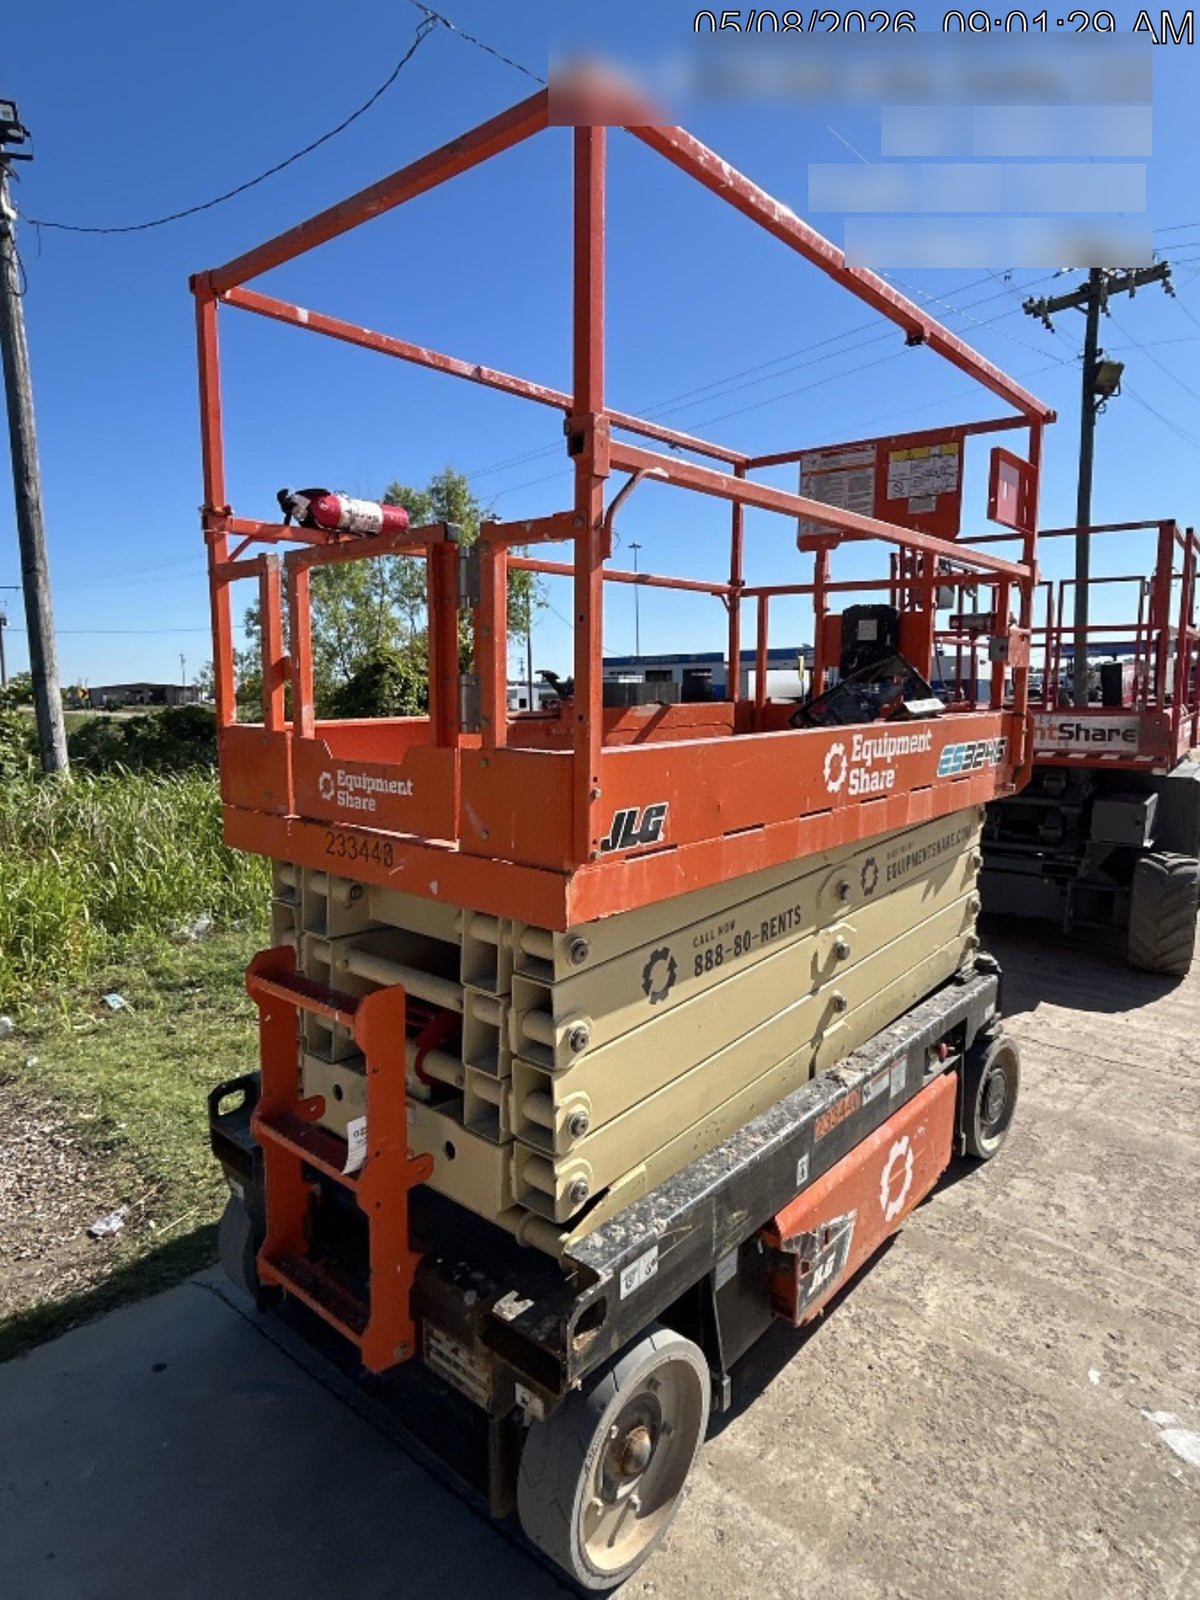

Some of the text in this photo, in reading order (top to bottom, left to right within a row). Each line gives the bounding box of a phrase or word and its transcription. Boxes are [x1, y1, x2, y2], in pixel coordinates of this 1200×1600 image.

[851, 728, 933, 766] Equipment
[337, 769, 413, 795] Equipment
[848, 767, 896, 795] Share
[337, 790, 376, 811] Share
[600, 801, 669, 850] JLG
[694, 904, 801, 977] 888-80-RENTS
